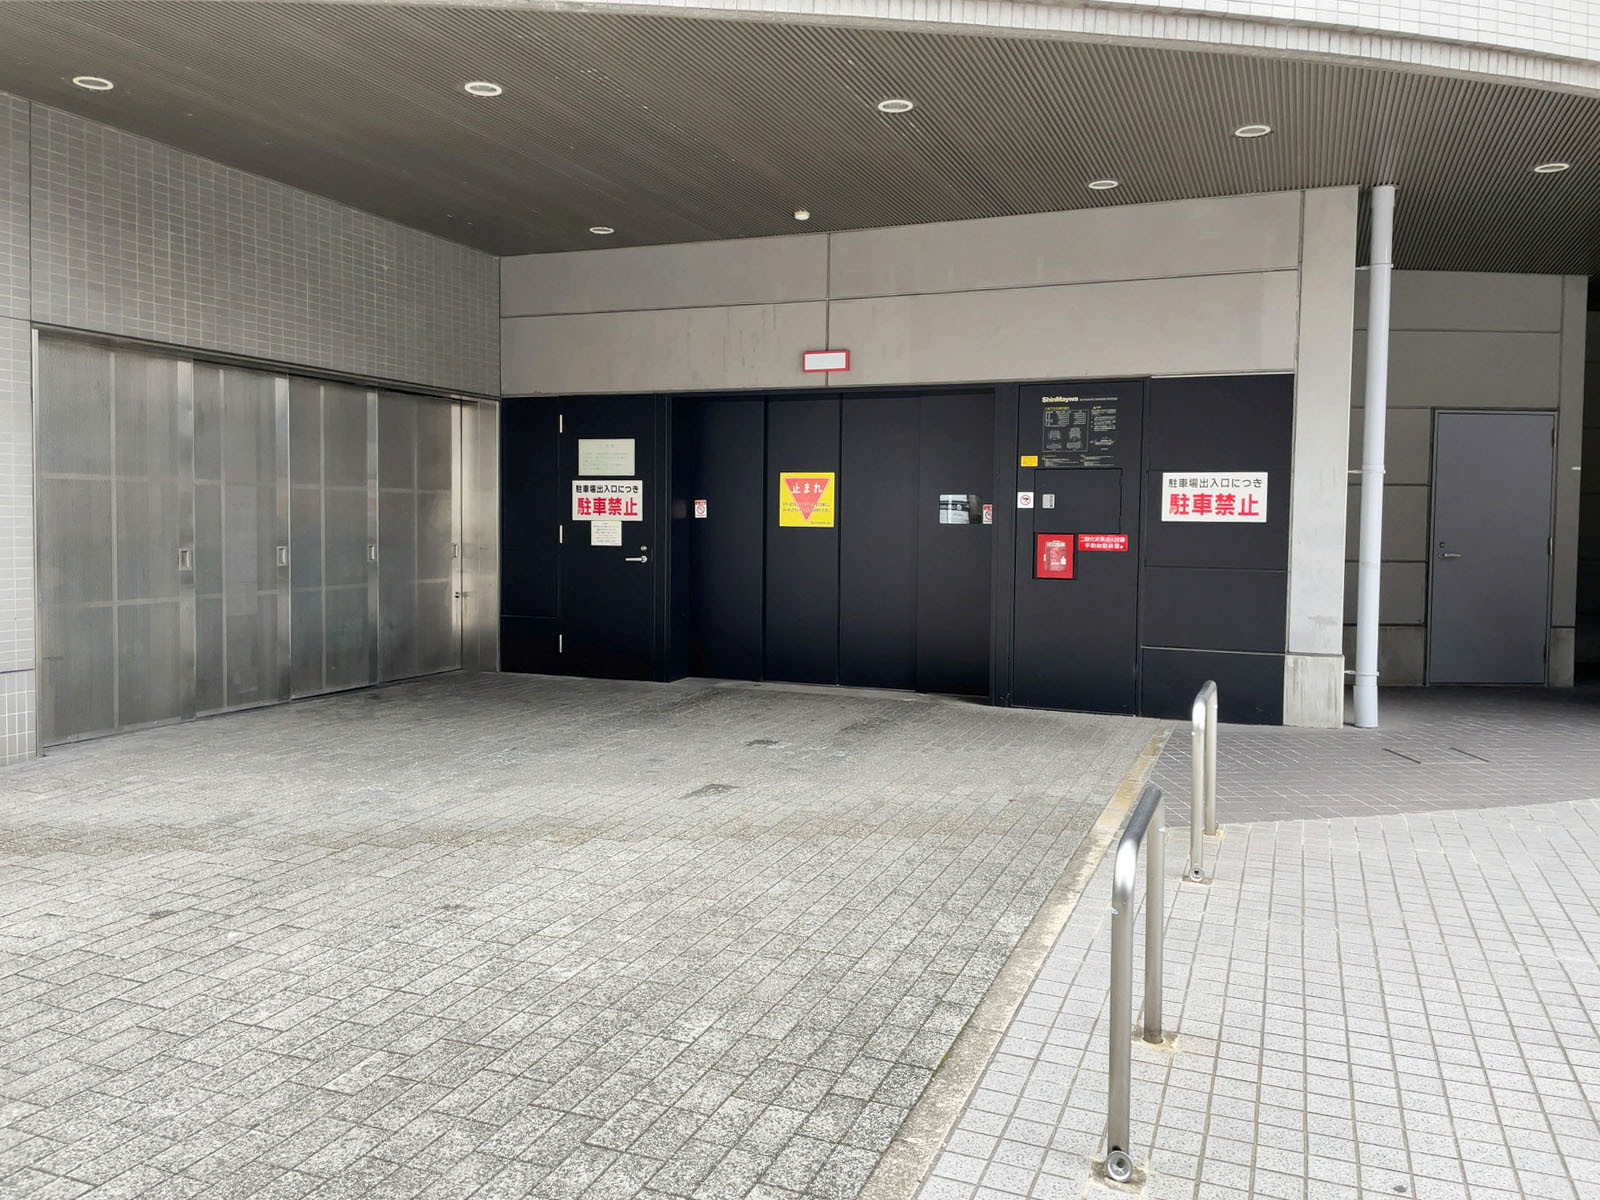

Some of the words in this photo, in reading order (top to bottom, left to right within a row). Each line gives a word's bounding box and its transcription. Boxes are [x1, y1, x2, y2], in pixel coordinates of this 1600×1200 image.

[575, 484, 639, 493] 駐車場出入口につき
[791, 482, 823, 494] 止まれ
[1167, 478, 1263, 488] 駐車場出入口につき
[577, 497, 638, 516] 駐車禁止
[1168, 493, 1260, 516] 駐車禁止
